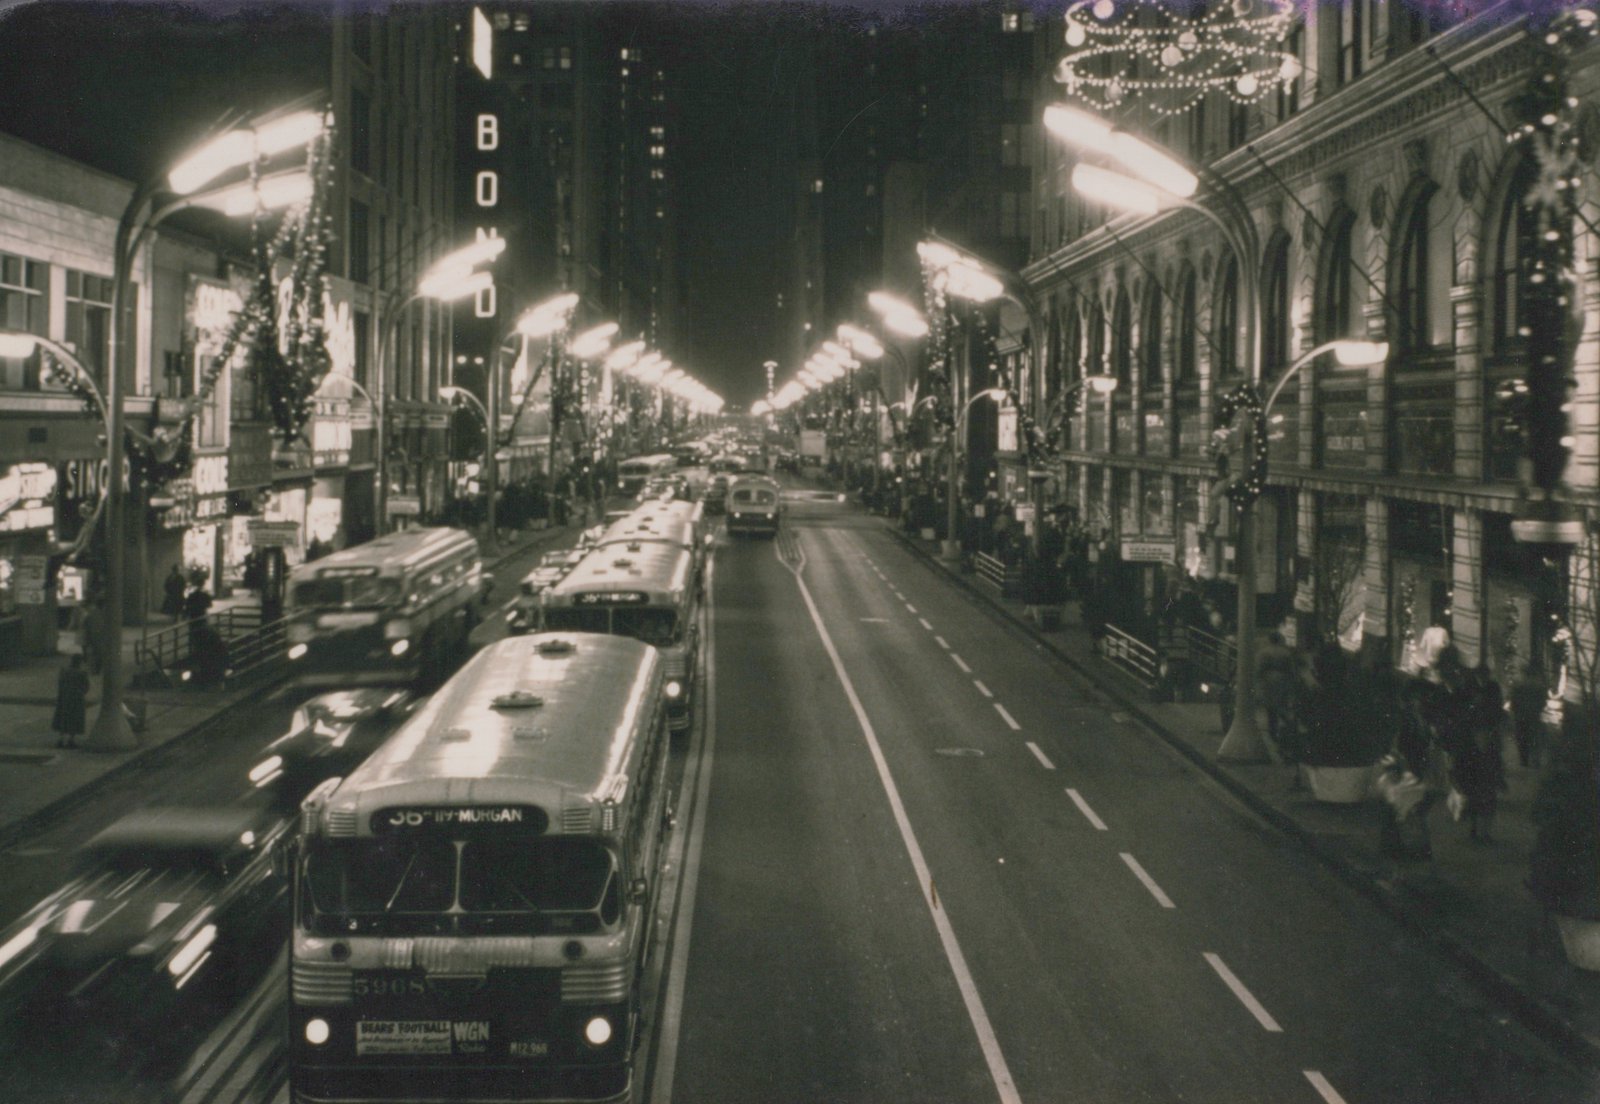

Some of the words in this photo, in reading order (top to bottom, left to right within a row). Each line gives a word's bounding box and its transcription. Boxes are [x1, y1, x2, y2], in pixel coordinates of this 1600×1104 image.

[66, 457, 131, 499] SINGR
[361, 1022, 394, 1034] BEARS
[398, 1021, 450, 1034] FOOTBALL
[453, 1020, 490, 1041] WGN
